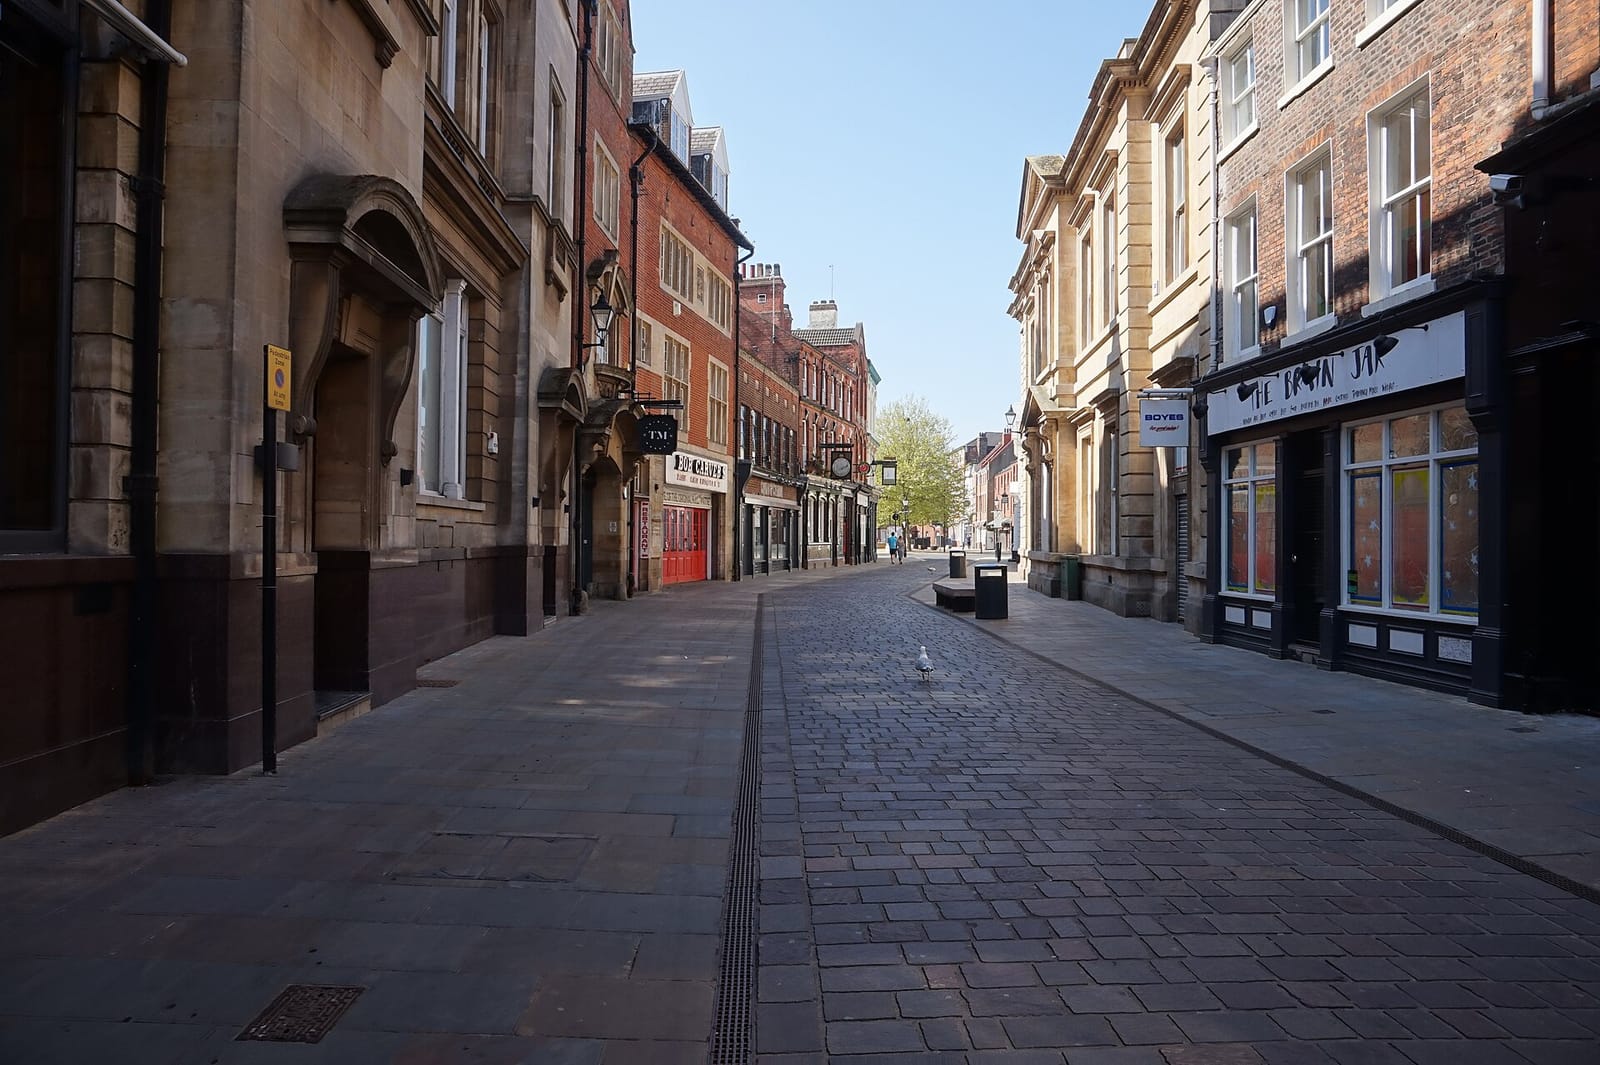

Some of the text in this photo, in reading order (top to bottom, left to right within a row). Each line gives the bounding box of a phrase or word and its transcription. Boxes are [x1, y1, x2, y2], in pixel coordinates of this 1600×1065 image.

[1284, 357, 1335, 401] BRIN
[1145, 413, 1184, 421] BOYES
[677, 454, 693, 472] BOB
[641, 507, 649, 552] RESTAURANT
